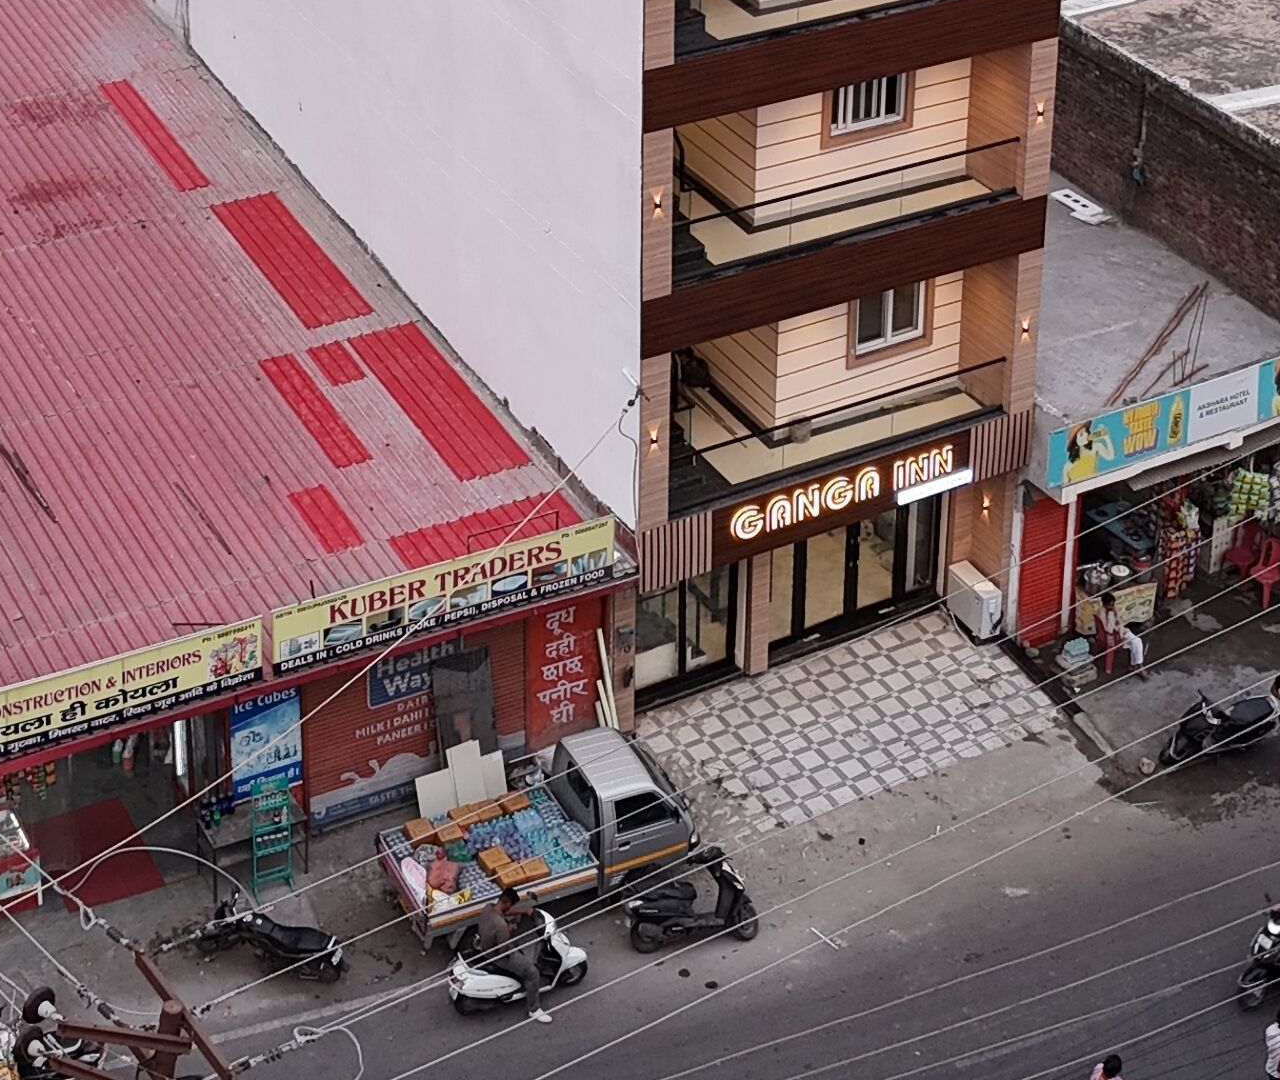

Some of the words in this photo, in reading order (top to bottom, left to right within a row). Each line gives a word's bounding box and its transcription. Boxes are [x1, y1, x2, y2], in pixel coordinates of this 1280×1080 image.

[1197, 398, 1228, 412] AKSHARA
[1229, 389, 1251, 402] HOTEL
[1198, 411, 1204, 419] &
[1205, 398, 1249, 417] RESTAURANT
[1123, 428, 1157, 456] WOW
[729, 466, 881, 540] GANGA
[893, 444, 954, 492] INN
[329, 578, 427, 624] KUBER
[434, 540, 563, 593] TRADERS
[280, 655, 314, 671] DEALS
[316, 650, 328, 661] IN
[335, 640, 364, 655] COLD
[365, 627, 403, 645] DRINKS
[481, 592, 528, 612] DISPOSAL
[530, 588, 538, 597] &
[540, 577, 578, 595] FROZEN
[579, 569, 605, 583] FOOD
[545, 605, 577, 636] दूध
[377, 639, 455, 678] Health
[545, 632, 576, 660] दही
[105, 675, 118, 690] &
[122, 649, 202, 685] INTERIORS
[541, 655, 584, 681] छाछ
[382, 672, 431, 698] Way
[536, 678, 589, 705] पनीर
[59, 699, 88, 723] ही
[94, 676, 180, 711] कोयला
[234, 702, 254, 715] Ice
[257, 687, 297, 707] Cubes
[550, 700, 576, 724] घी
[355, 721, 384, 739] MILK
[376, 724, 421, 745] PANEER
